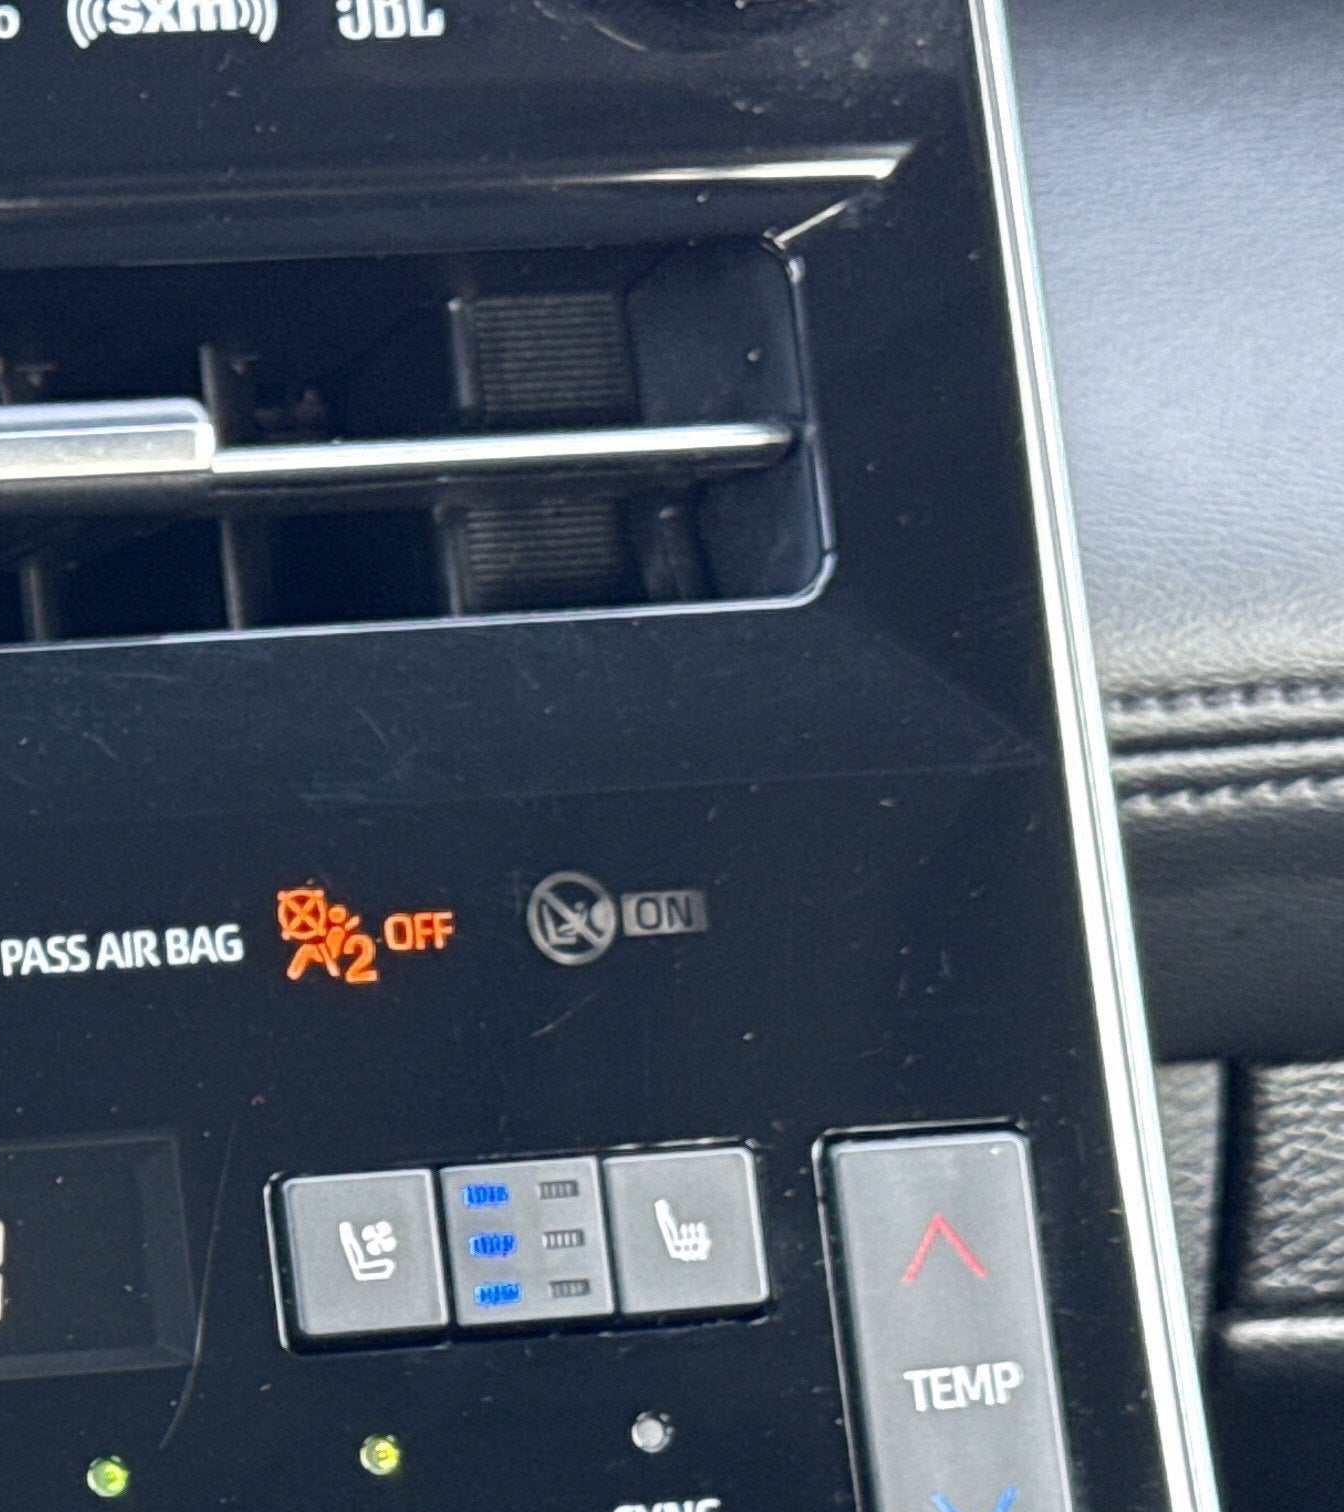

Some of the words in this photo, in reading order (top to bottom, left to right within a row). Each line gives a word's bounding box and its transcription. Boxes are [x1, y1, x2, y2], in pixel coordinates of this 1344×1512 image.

[335, 0, 446, 40] JBL
[634, 893, 694, 932] ON
[0, 933, 90, 977] PASS
[96, 930, 161, 971] AIR
[166, 924, 244, 967] BAG
[384, 911, 454, 951] OFF
[904, 1361, 1023, 1413] TEMP
